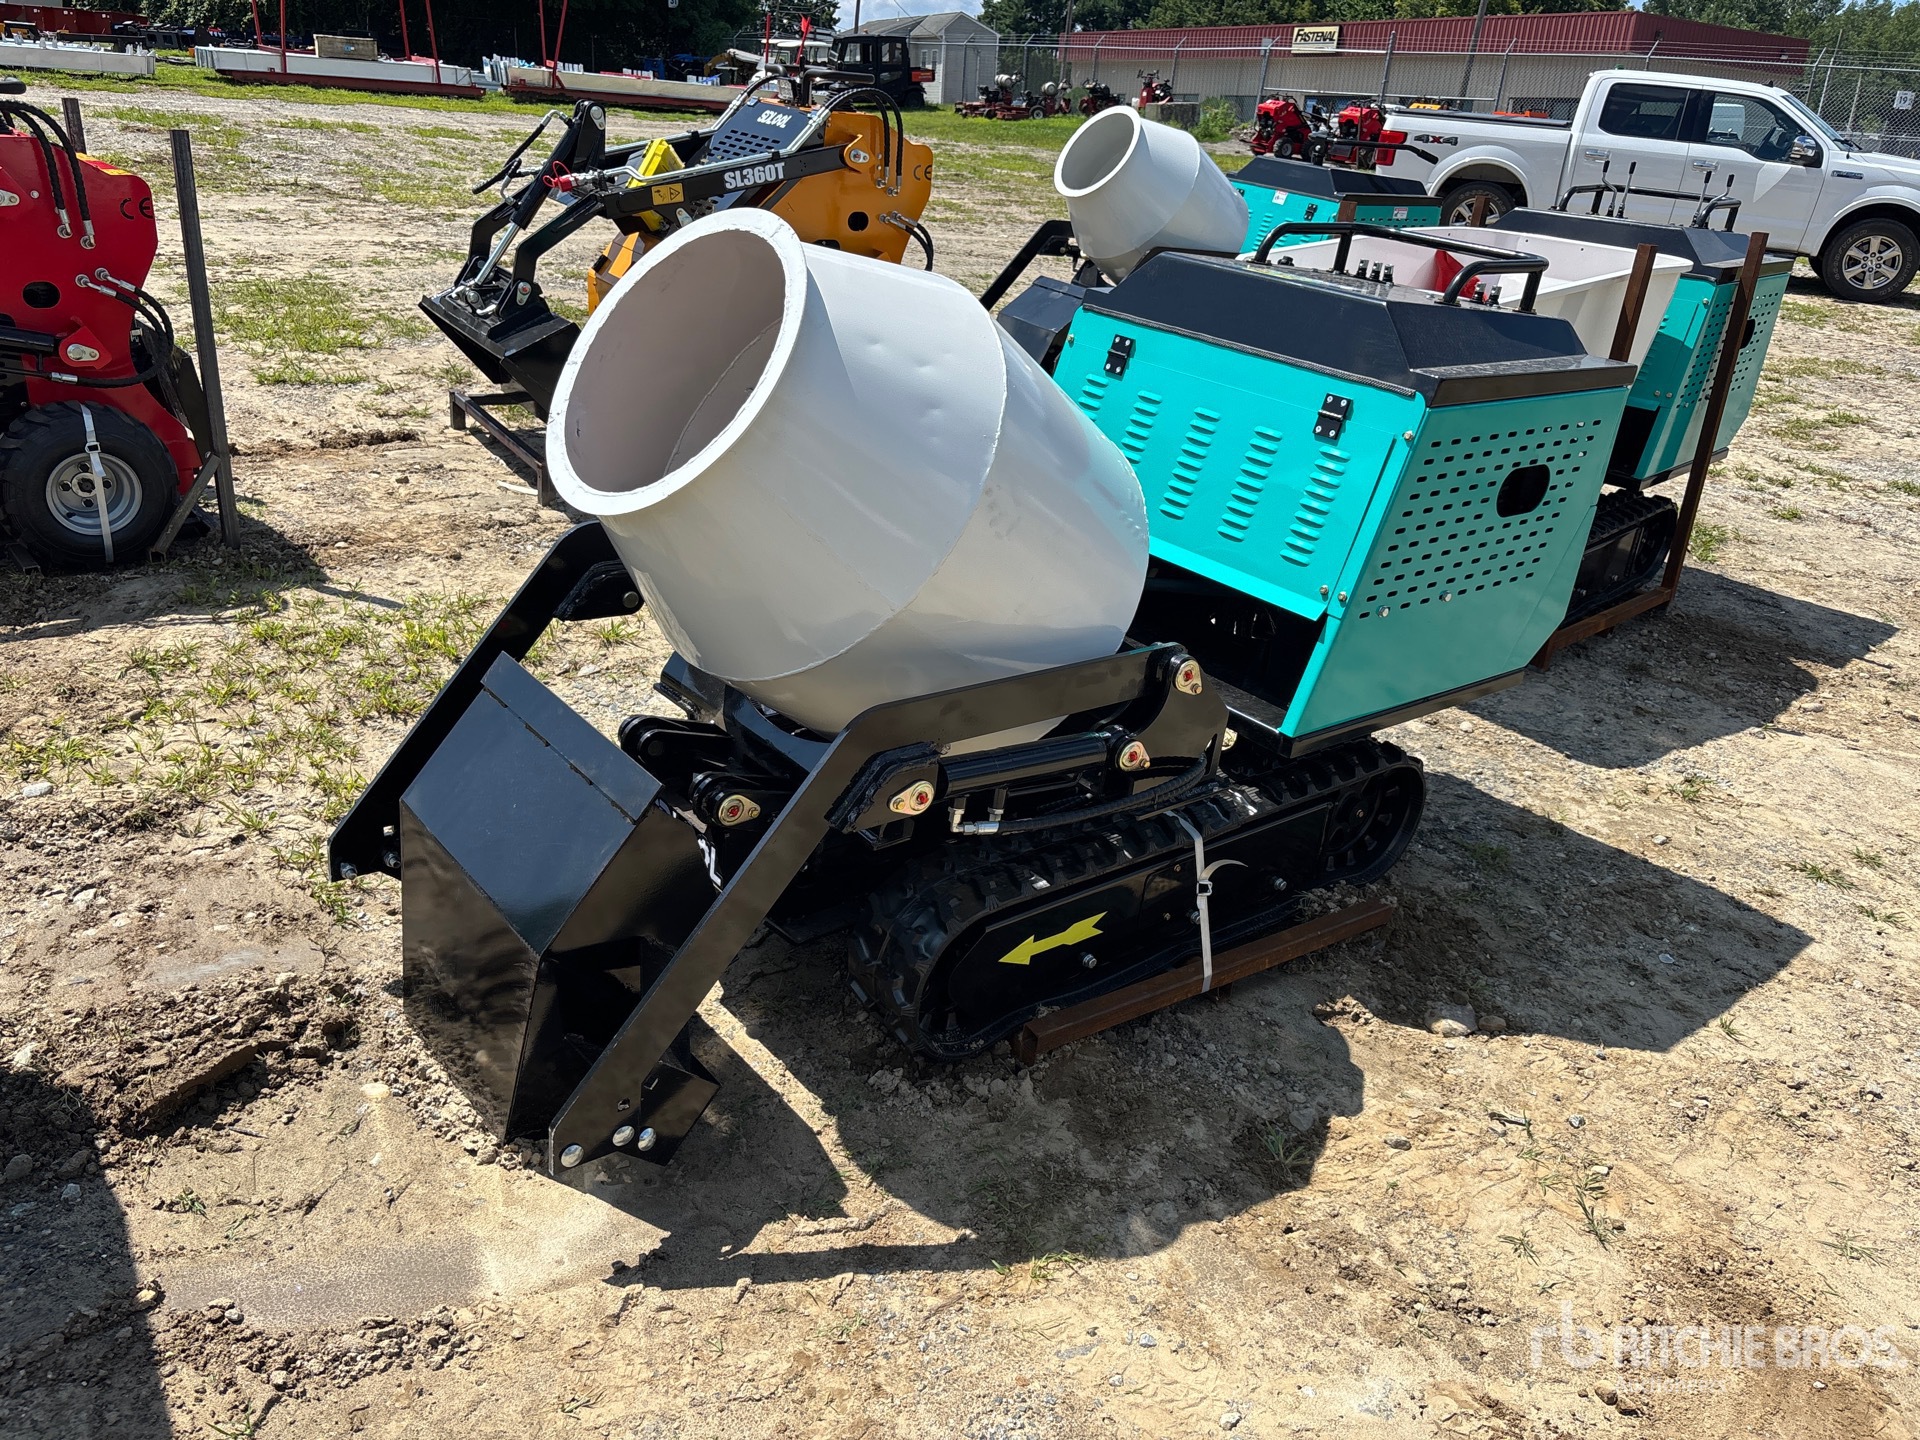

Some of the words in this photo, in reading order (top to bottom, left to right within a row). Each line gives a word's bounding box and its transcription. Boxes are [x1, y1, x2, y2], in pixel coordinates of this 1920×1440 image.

[1294, 28, 1336, 42] FASTENAL
[724, 161, 785, 189] SL360T
[913, 164, 932, 181] CE
[120, 197, 154, 220] CE
